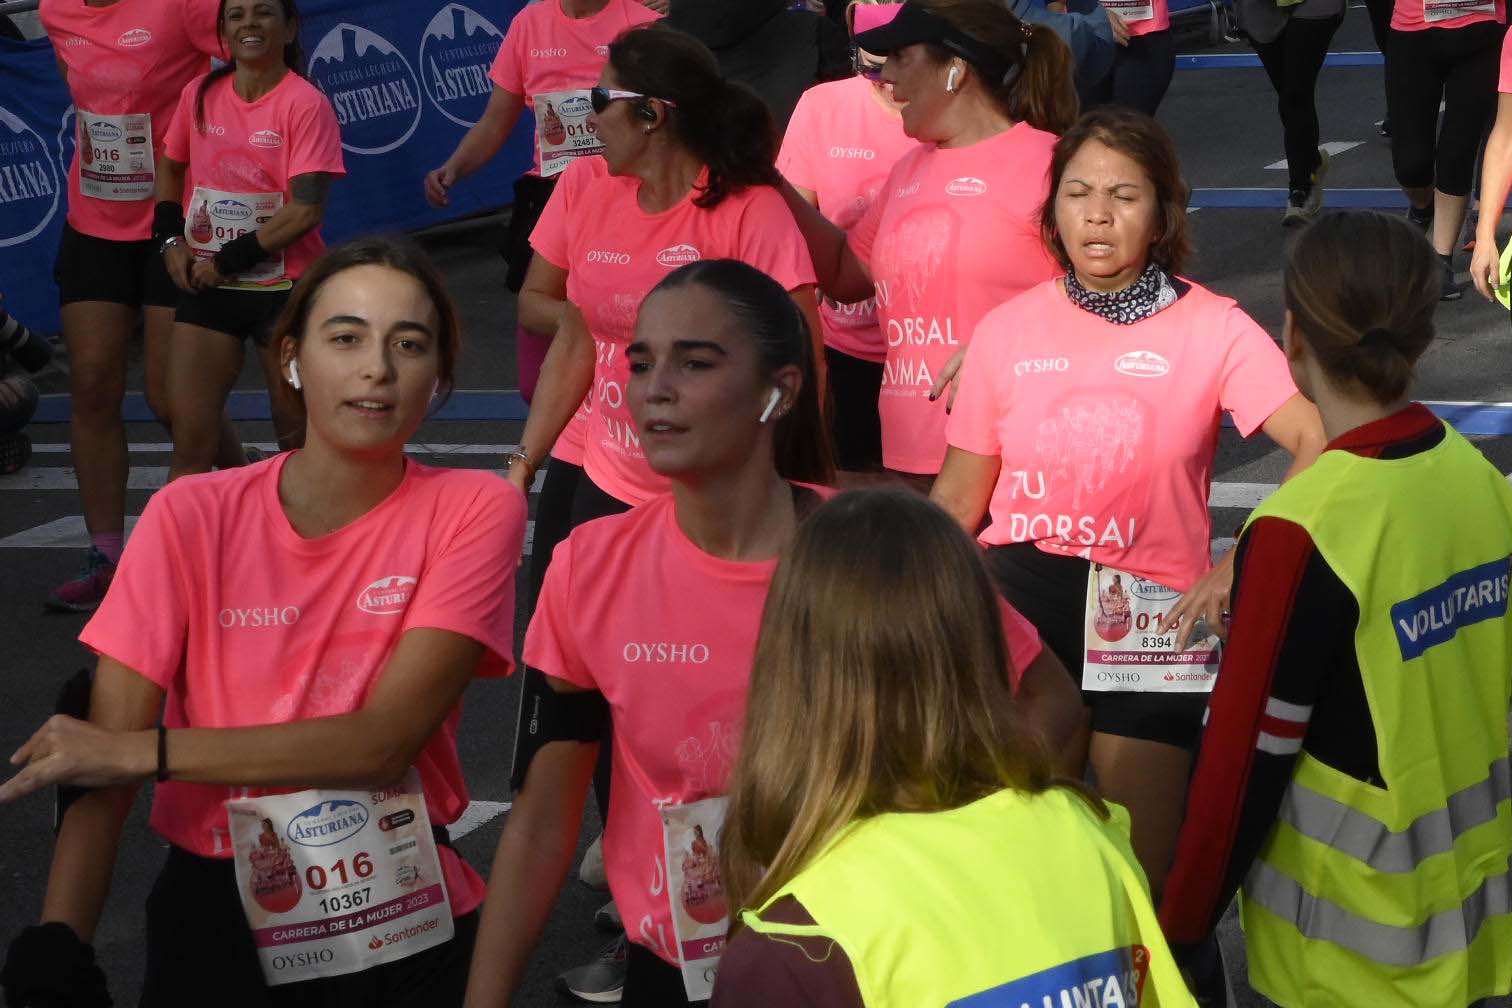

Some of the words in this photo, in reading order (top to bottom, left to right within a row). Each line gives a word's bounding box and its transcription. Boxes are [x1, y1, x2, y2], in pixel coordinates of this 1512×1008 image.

[333, 78, 416, 126] STURIANA
[567, 123, 596, 136] 016
[573, 137, 595, 147] 32487
[93, 148, 120, 161] 016
[830, 147, 875, 161] OYSHO
[213, 204, 249, 216] ASTURIANA
[587, 249, 631, 266] OYSHO
[660, 252, 698, 262] ASTURIANA
[888, 317, 958, 347] ORSAL
[1014, 357, 1069, 376] OYSHO
[1118, 358, 1167, 372] ASTURIANA
[1011, 470, 1046, 500] TU
[218, 606, 300, 628] OYSHO
[1141, 637, 1172, 649] 8394
[622, 642, 711, 665] OYSHO
[1101, 653, 1139, 662] CARRERA
[1141, 653, 1152, 662] DE
[1154, 653, 1164, 662] LA
[1166, 653, 1193, 662] MUJER
[1097, 671, 1141, 683] OYSHO
[293, 813, 366, 840] ASTURIANA
[305, 851, 374, 890] 016
[319, 887, 372, 914] 10367
[272, 924, 327, 942] CARRERA
[329, 920, 347, 933] DE
[349, 916, 364, 929] LA
[366, 903, 403, 925] MUJER
[406, 894, 430, 910] 2023
[384, 917, 440, 946] Santander
[272, 948, 334, 970] OYSHO
